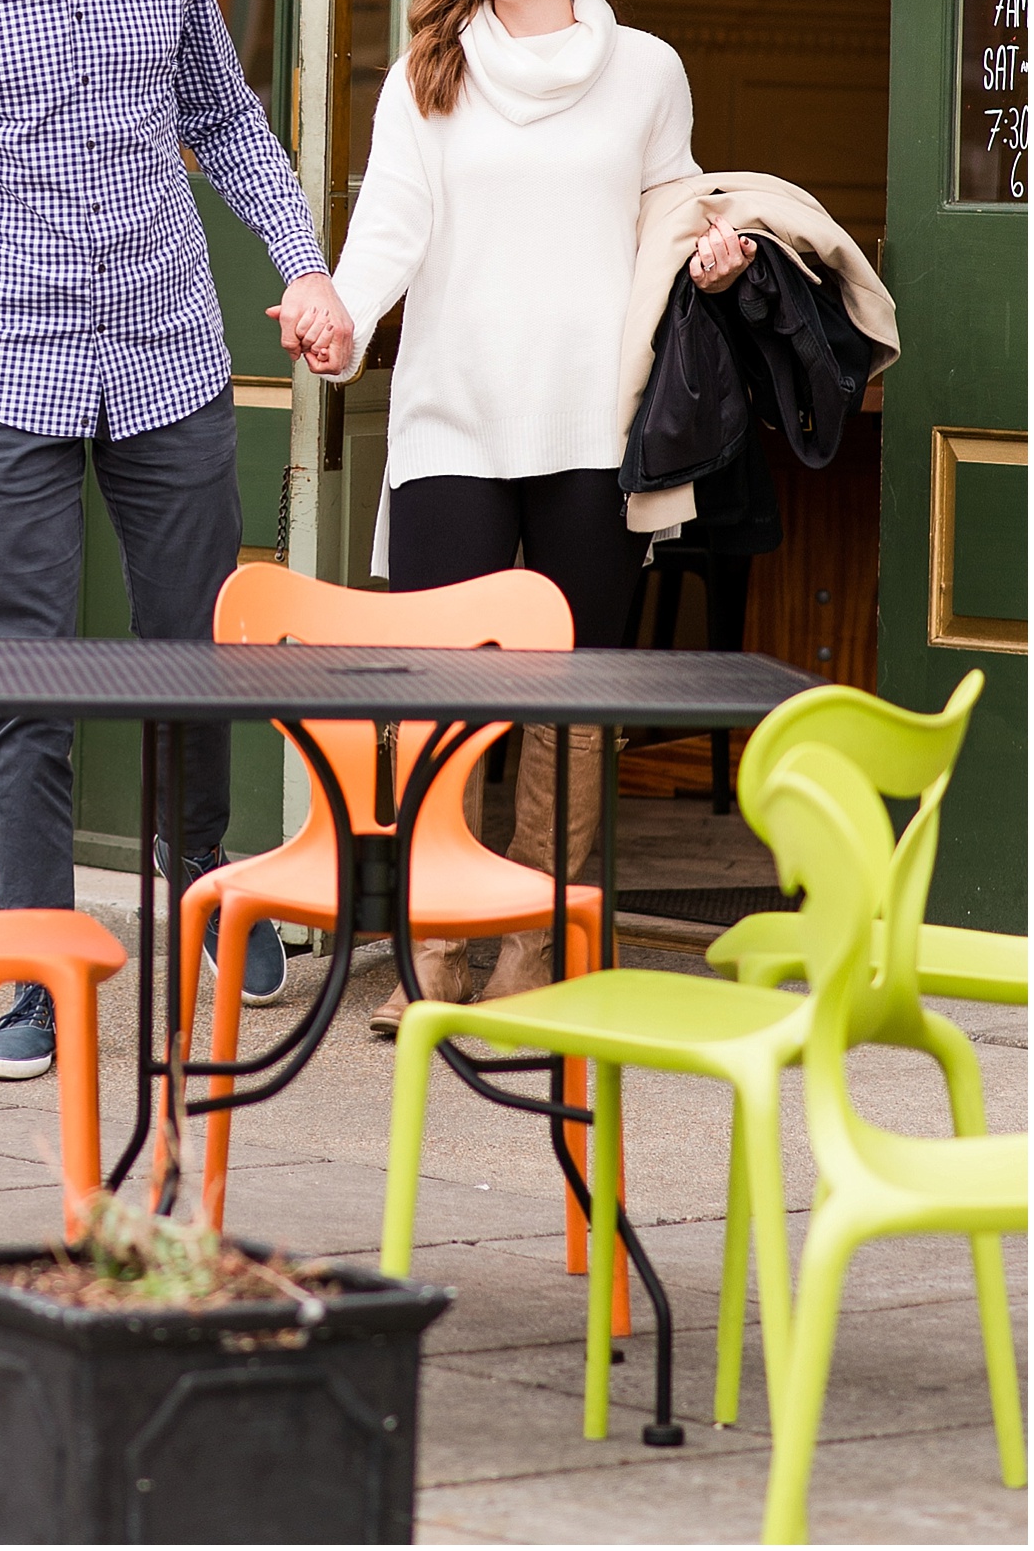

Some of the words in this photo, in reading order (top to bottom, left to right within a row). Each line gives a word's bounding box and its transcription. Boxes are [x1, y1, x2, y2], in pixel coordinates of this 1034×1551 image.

[984, 45, 1019, 90] SAT
[984, 105, 1028, 151] 7:30
[1011, 151, 1024, 197] 6
